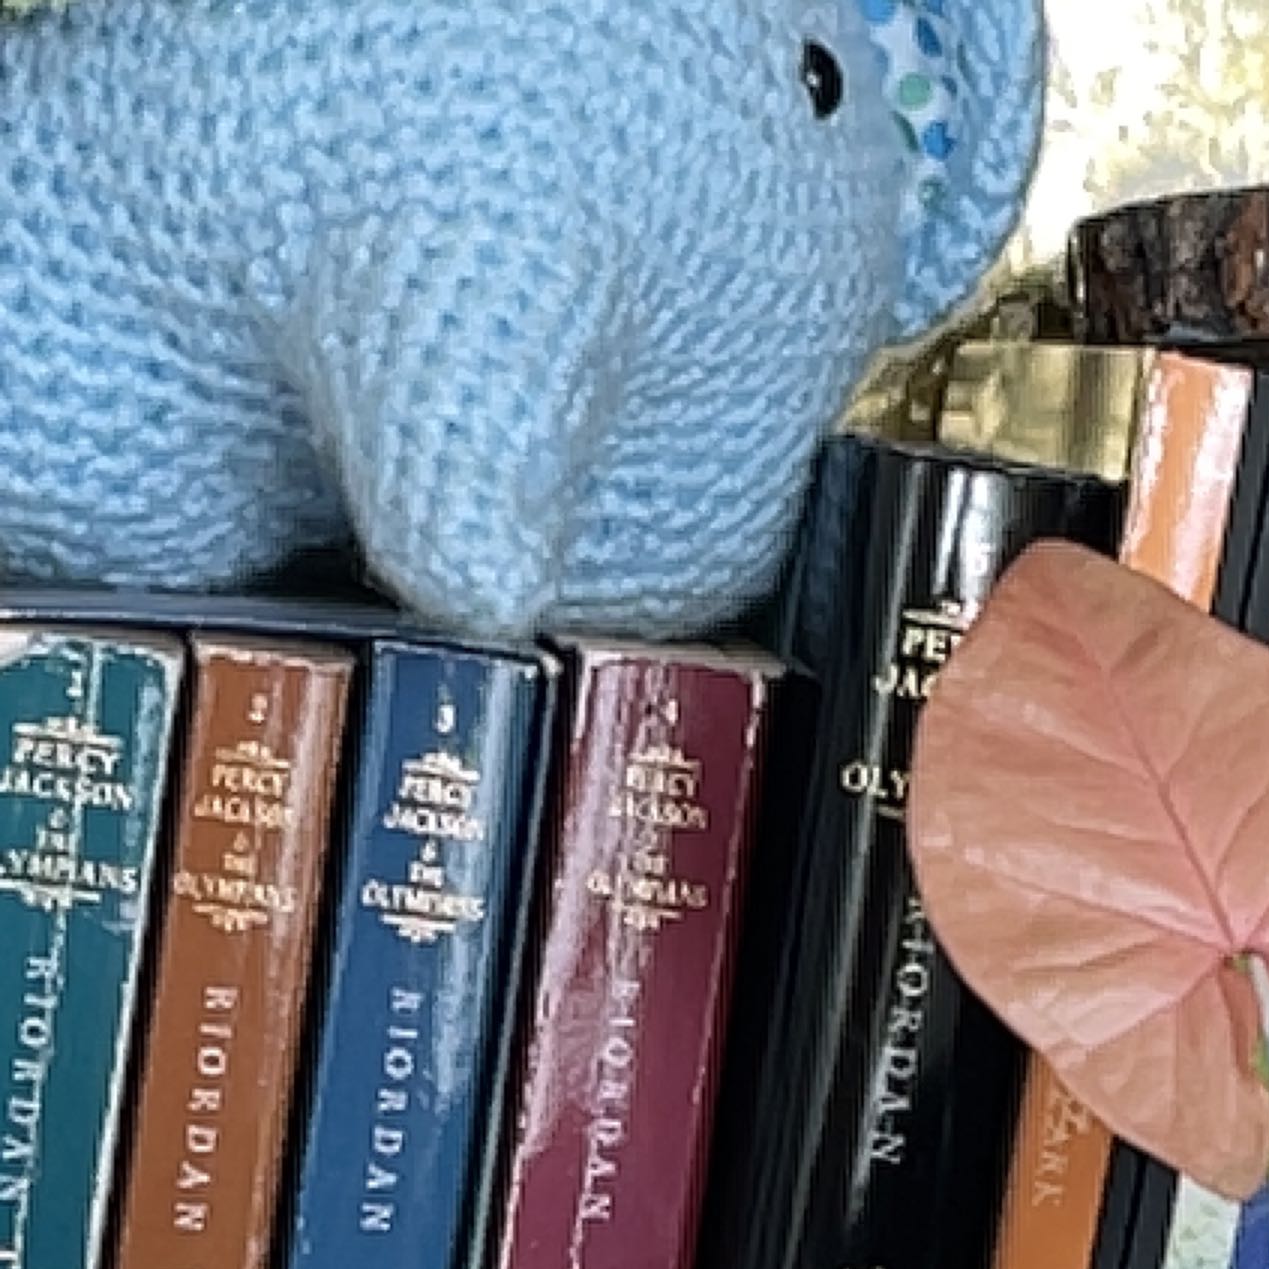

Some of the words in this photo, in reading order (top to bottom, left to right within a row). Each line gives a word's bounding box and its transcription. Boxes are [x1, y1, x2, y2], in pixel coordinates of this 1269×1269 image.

[13, 737, 122, 776] PERCY
[0, 766, 133, 811] JACKSON
[212, 764, 290, 797] PERCY
[400, 776, 475, 808] PERCY
[626, 763, 697, 797] PERCY
[194, 794, 297, 829] JACKSON
[384, 803, 485, 841] JACKSON
[609, 790, 707, 829] JACKSON
[0, 848, 138, 894] YMPIANS
[173, 871, 297, 914] OLYMPIANS
[362, 879, 485, 922] OLYMPIANS
[0, 955, 60, 1202] RIORDAN
[579, 979, 642, 1221] RIORDAN
[173, 985, 239, 1232] RIORDAN
[360, 988, 423, 1232] RIORDAN
